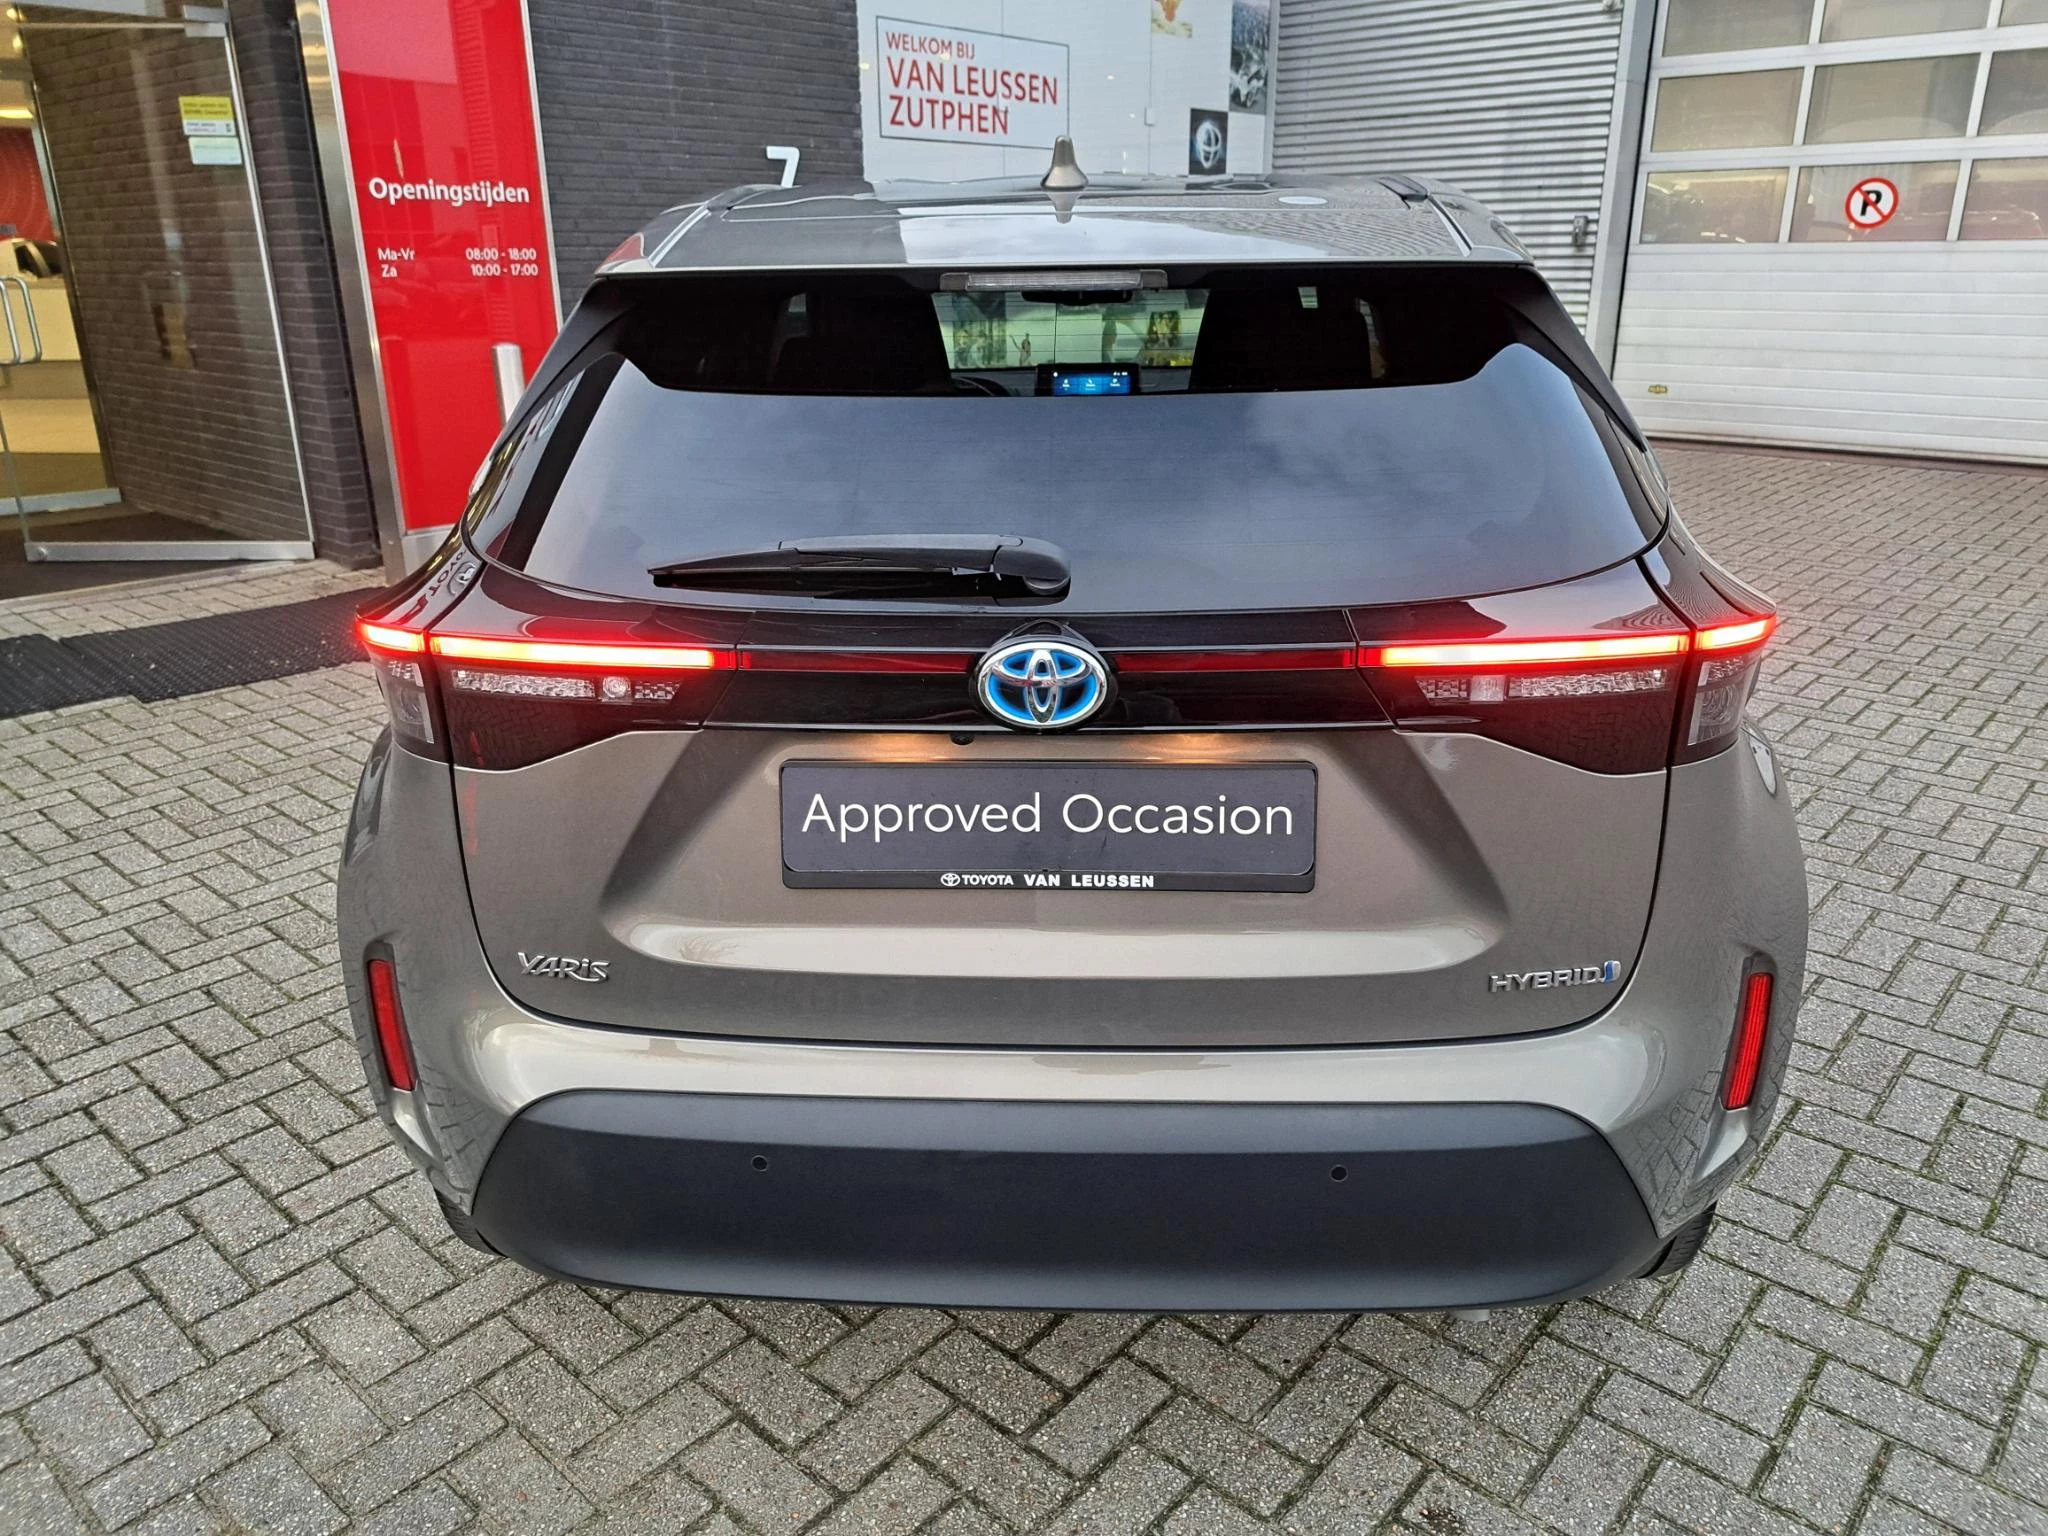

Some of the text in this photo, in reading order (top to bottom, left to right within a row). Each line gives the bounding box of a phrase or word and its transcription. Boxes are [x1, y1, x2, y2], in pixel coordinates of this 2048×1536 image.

[885, 31, 976, 60] WELKOM BIJ
[887, 55, 1058, 105] VAN LEUSSEN
[888, 95, 1009, 135] ZUTPHEN
[766, 145, 800, 188] 7
[368, 176, 530, 207] Openingstijden
[377, 247, 415, 261] Ma-Vr
[465, 247, 499, 261] 08:00
[508, 248, 537, 261] 18:00
[381, 264, 398, 278] Za
[471, 263, 501, 277] 10:00
[510, 263, 539, 277] 17:00
[801, 791, 1294, 843] Approved Occasion
[961, 873, 1155, 888] TOYOTA VAN LEUSSEN
[1490, 966, 1602, 993] HYBRID
